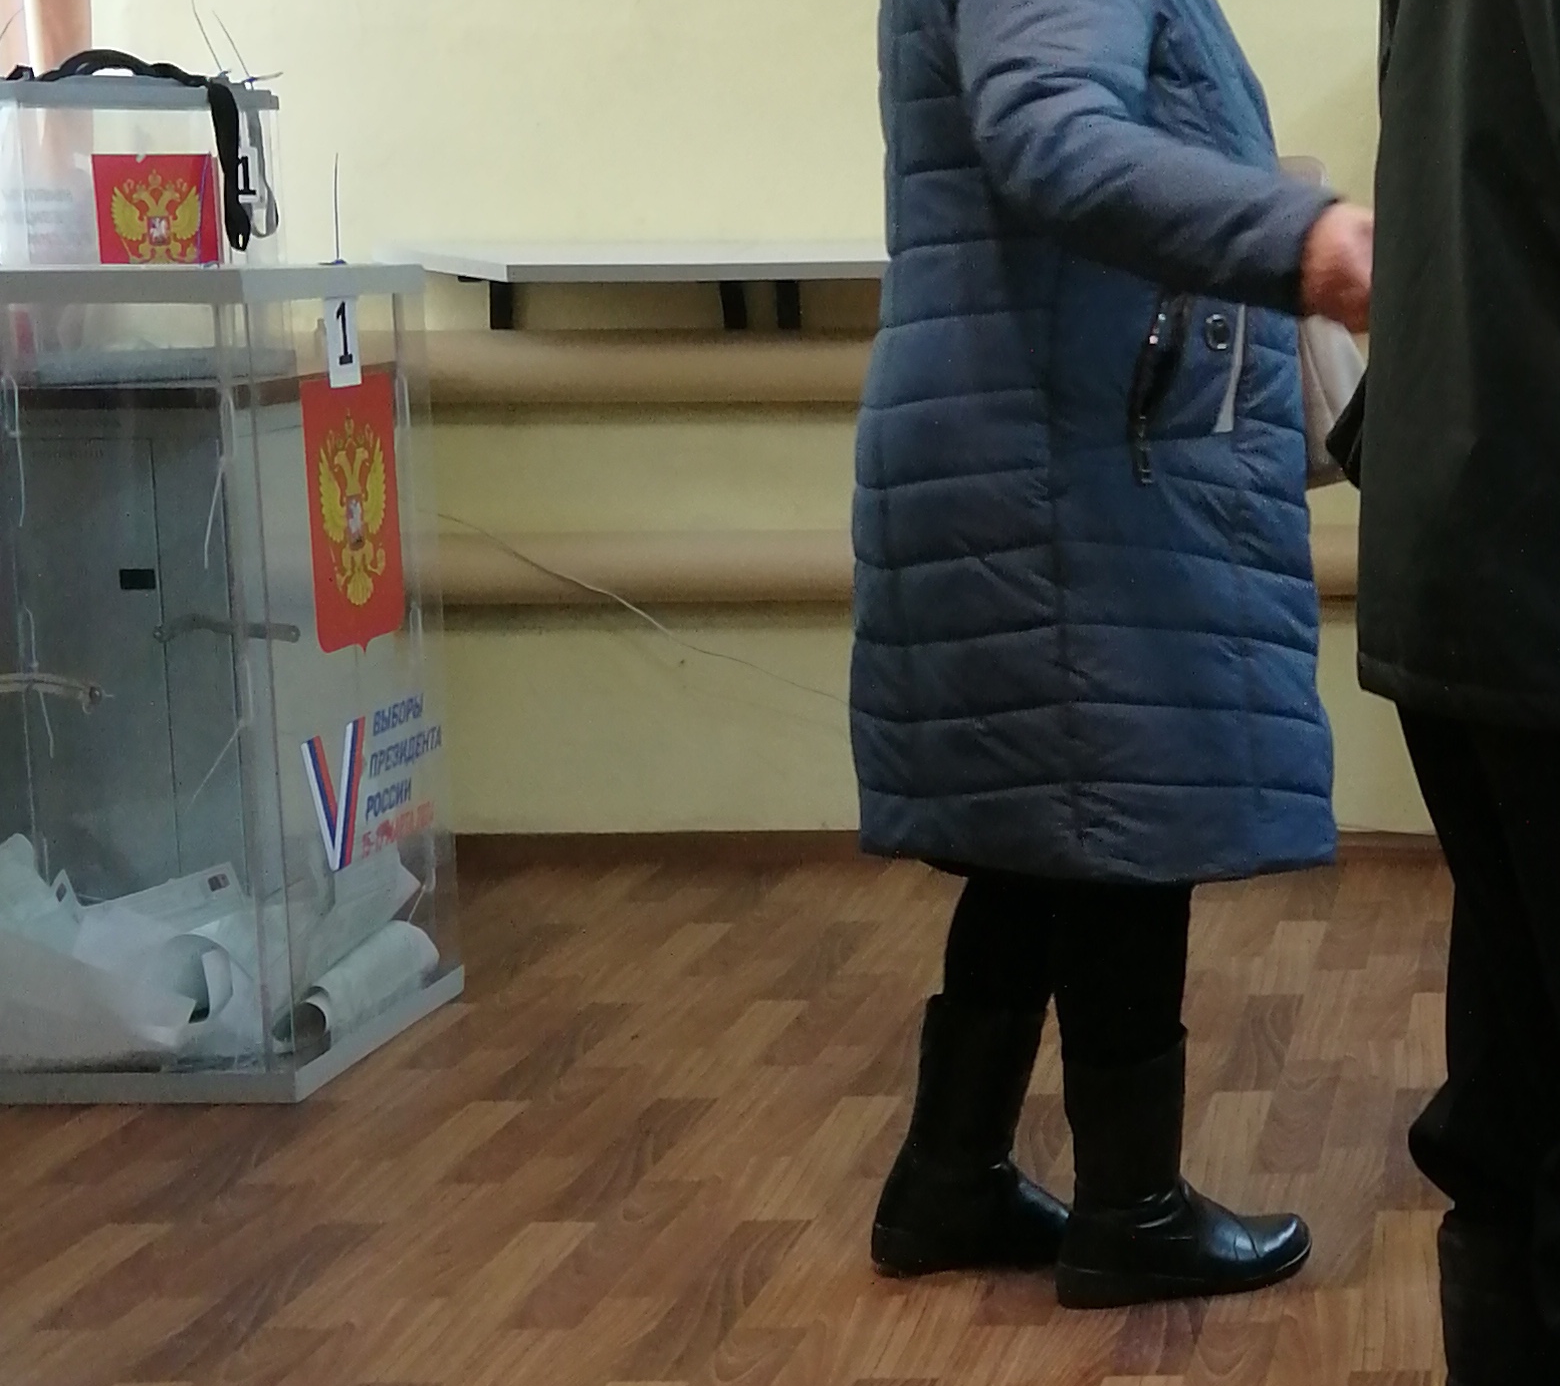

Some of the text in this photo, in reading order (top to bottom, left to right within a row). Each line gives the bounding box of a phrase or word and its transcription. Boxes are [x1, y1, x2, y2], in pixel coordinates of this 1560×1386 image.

[336, 301, 353, 365] 1
[373, 693, 425, 737] ВЫБОРЫ
[369, 725, 442, 779] ПРЕЗИДЕНТА
[365, 777, 412, 825] РОССИИ
